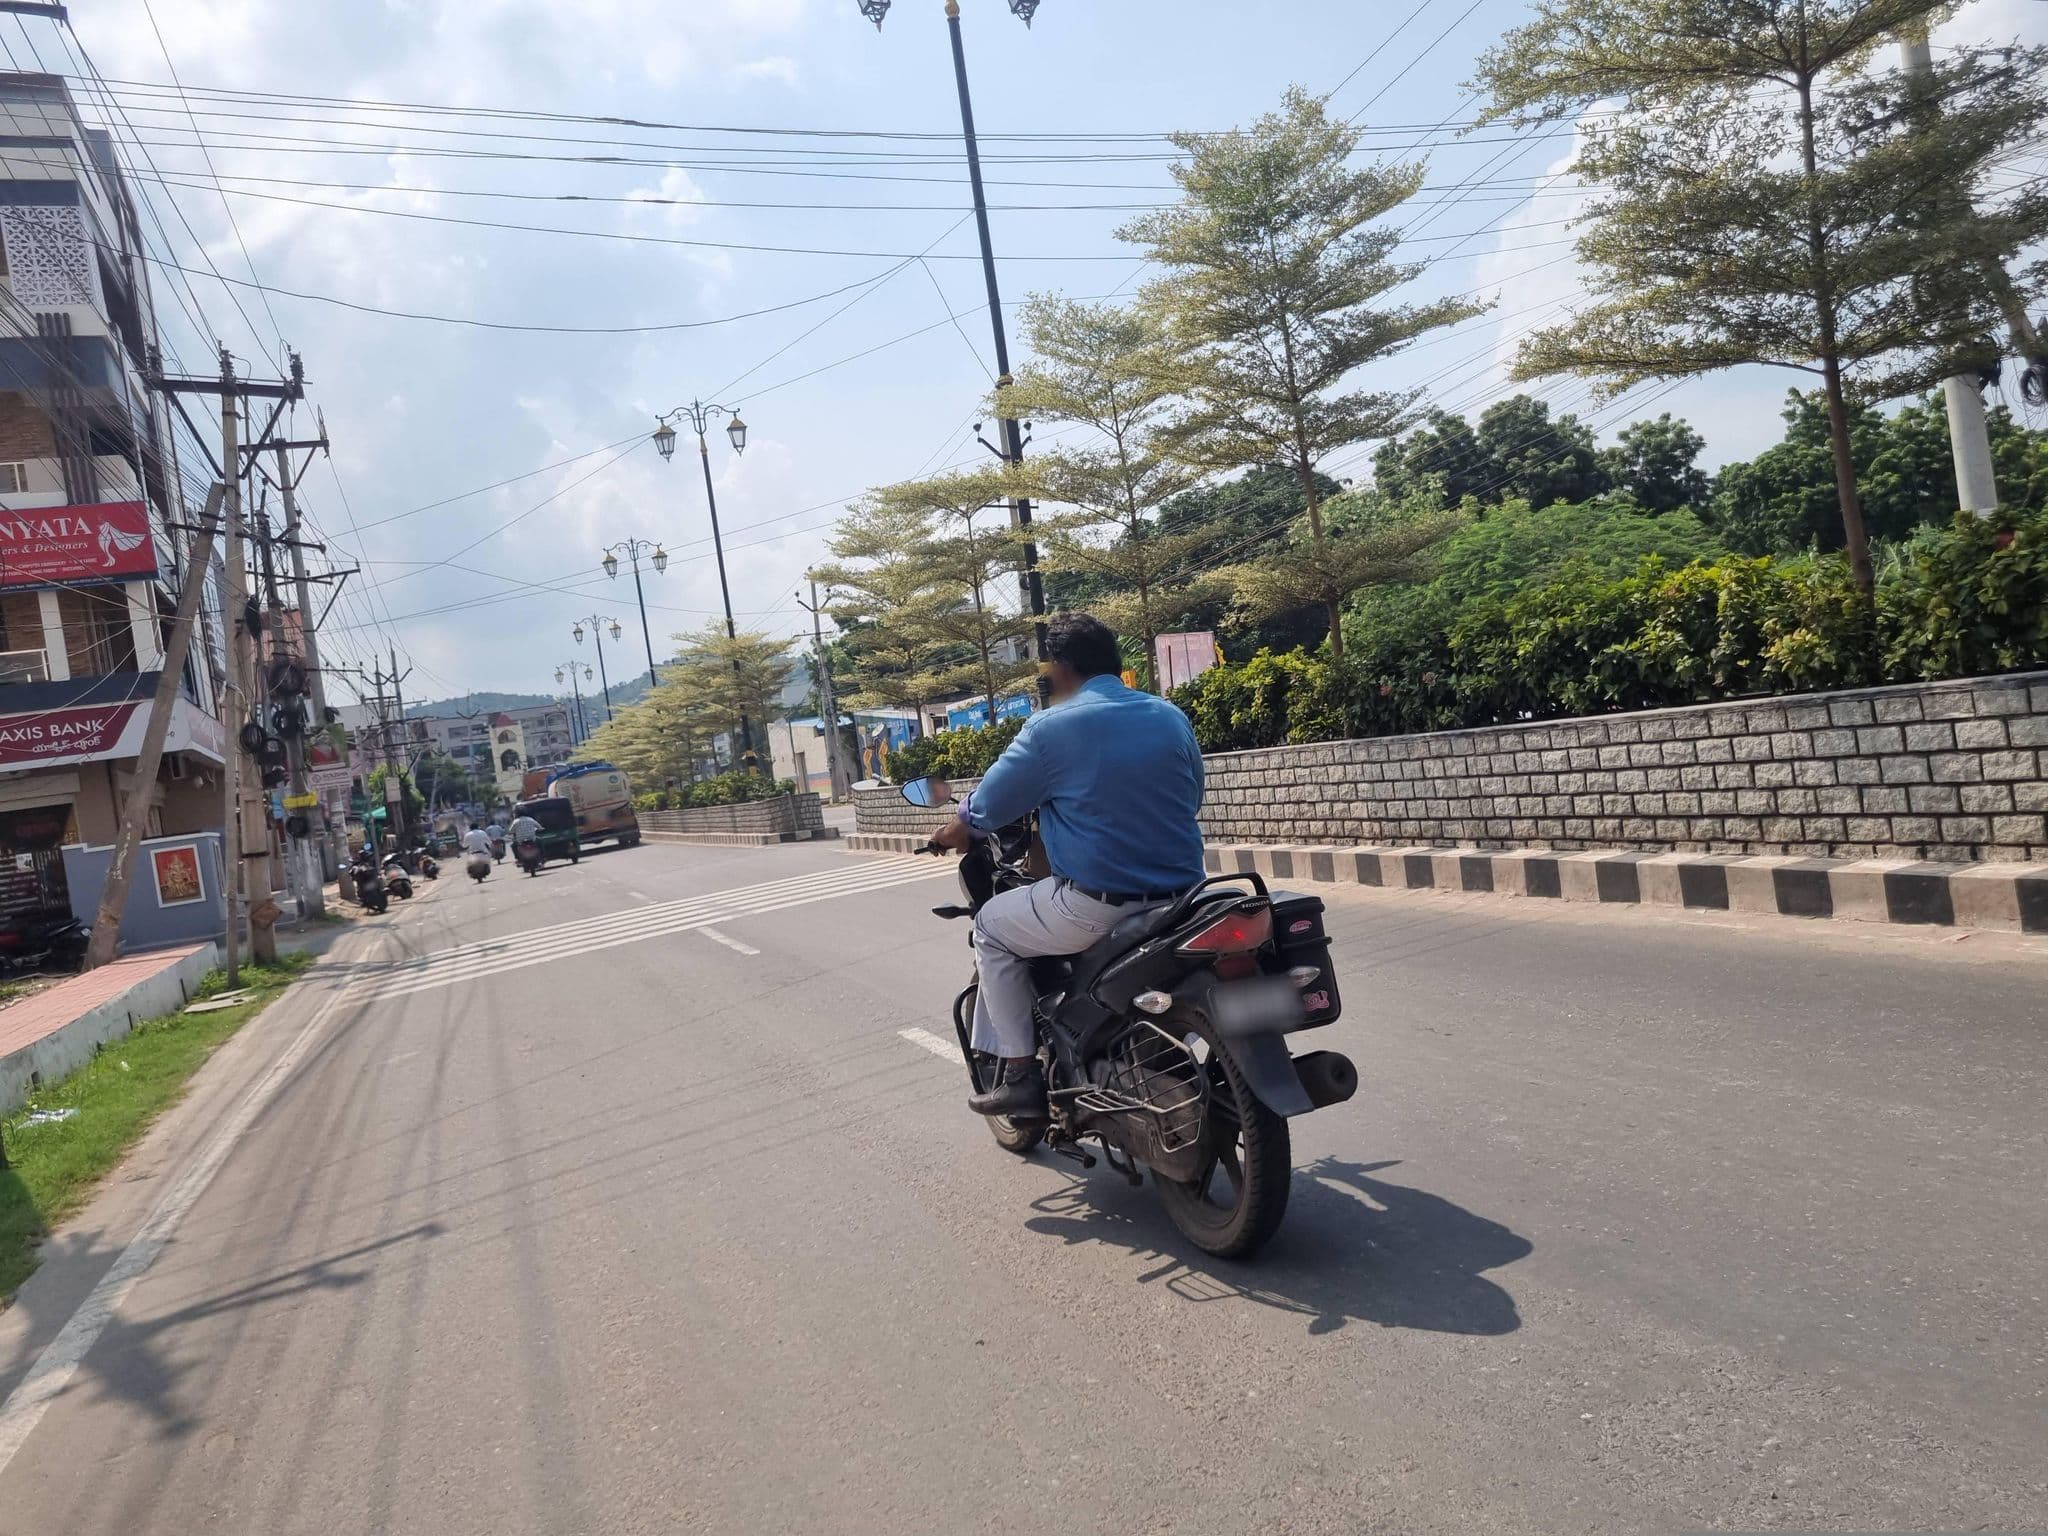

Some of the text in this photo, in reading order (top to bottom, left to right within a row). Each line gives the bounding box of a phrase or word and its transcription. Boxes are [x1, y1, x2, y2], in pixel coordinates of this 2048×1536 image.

[21, 544, 31, 554] &
[35, 541, 89, 553] Designers
[0, 719, 104, 742] AXIS BANK
[1242, 899, 1269, 908] HONDA
